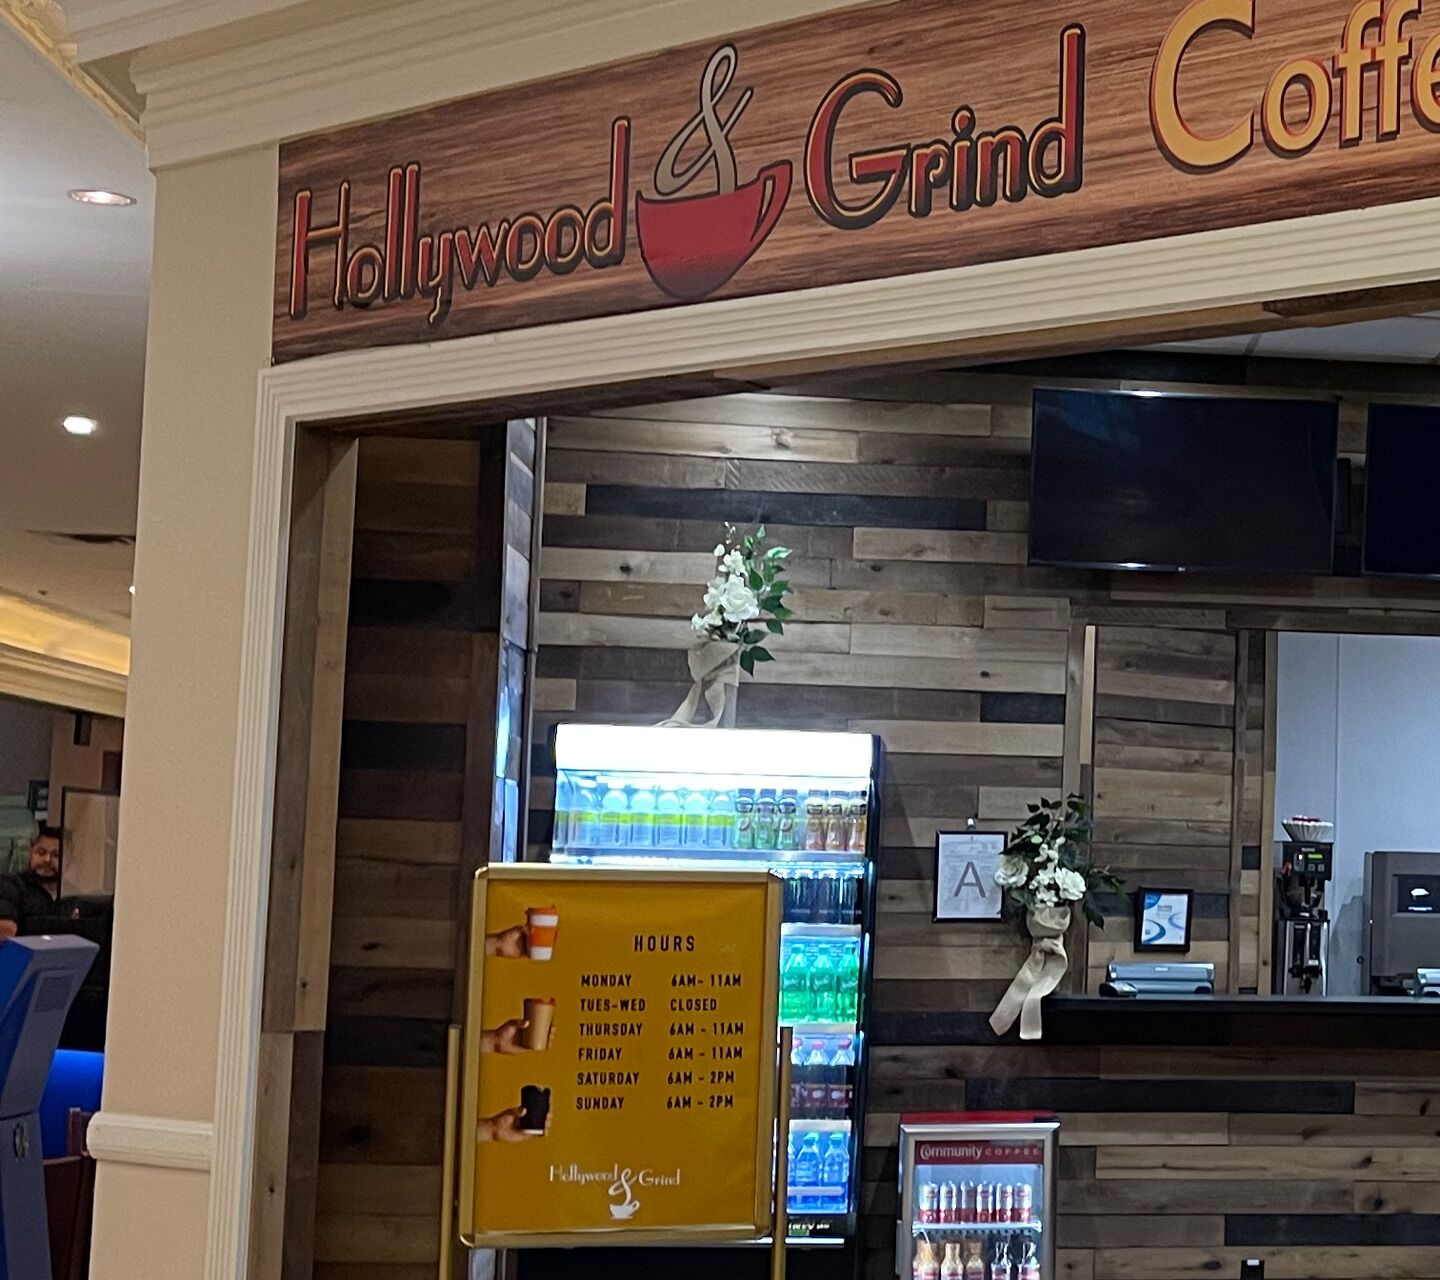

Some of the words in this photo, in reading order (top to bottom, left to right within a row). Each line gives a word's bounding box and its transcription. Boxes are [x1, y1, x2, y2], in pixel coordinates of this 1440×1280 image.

[288, 116, 631, 323] Hollywood
[654, 43, 755, 199] &
[803, 23, 1086, 230] Grind
[953, 861, 987, 898] A
[633, 935, 696, 952] HOURS
[581, 974, 632, 987] MONDAY
[710, 973, 742, 987] 11AM
[580, 998, 646, 1012] TUES-WED
[670, 998, 717, 1012] CLOSED
[579, 1023, 643, 1036] THURSDAY
[669, 1023, 695, 1036] 6AM
[712, 1022, 744, 1036] 11AM
[578, 1048, 622, 1061] FRIDAY
[668, 1047, 694, 1060] 6AM
[711, 1046, 743, 1060] 11AM
[577, 1072, 640, 1086] SATURDAY
[667, 1072, 692, 1085] 6AM
[710, 1071, 735, 1084] 2PM
[576, 1096, 624, 1110] SUNDAY
[666, 1096, 692, 1109] 6AM
[709, 1095, 734, 1109] 2PM
[919, 1143, 984, 1160] Community
[984, 1147, 1040, 1157] COFFEE
[549, 1162, 618, 1185] Hollywood
[638, 1168, 681, 1187] Grind
